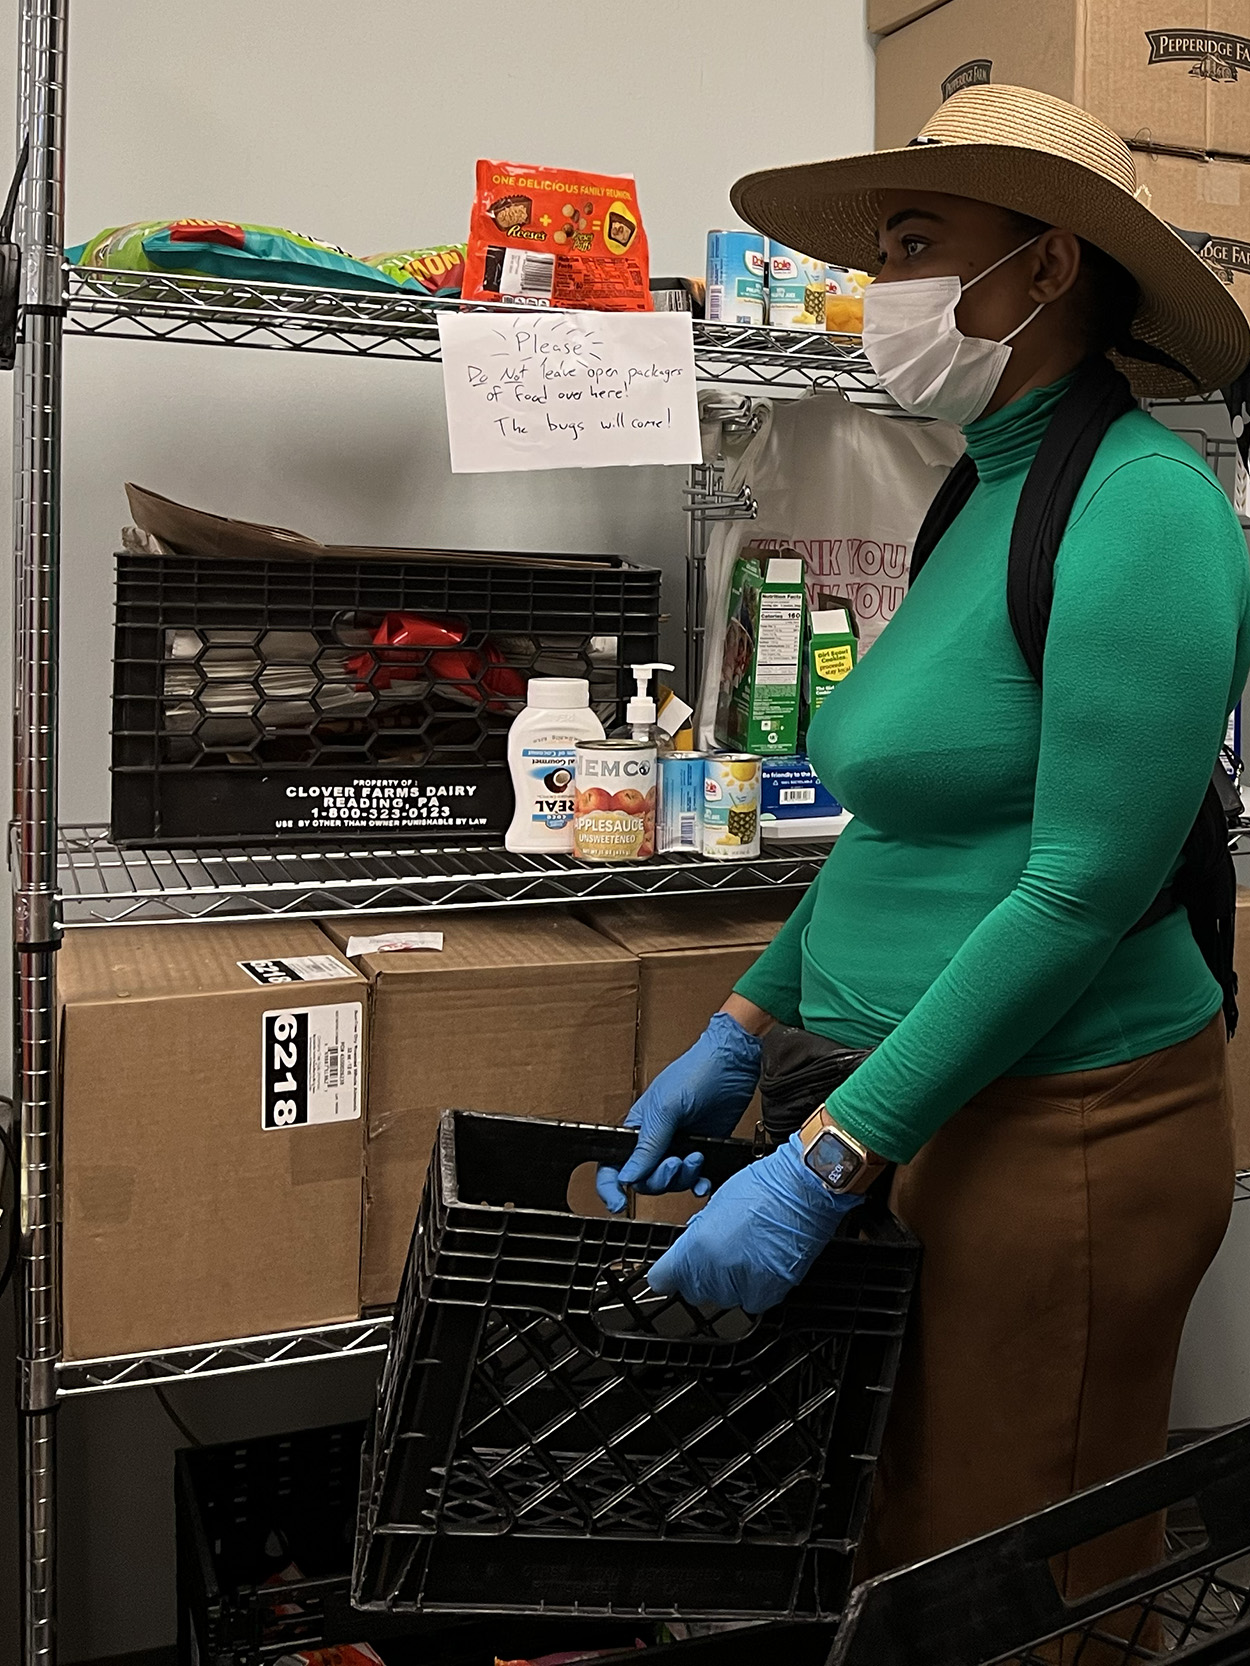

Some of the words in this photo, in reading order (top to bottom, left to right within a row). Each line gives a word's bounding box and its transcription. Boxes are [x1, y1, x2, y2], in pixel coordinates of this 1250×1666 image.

[1159, 35, 1233, 57] PEPPERIDGE
[492, 175, 516, 186] ONE
[518, 178, 579, 194] DELICIOUS
[580, 185, 605, 196] FAMILY
[507, 225, 547, 241] Reese's
[773, 259, 791, 269] Dole
[825, 282, 837, 293] ole
[515, 331, 583, 356] Please
[467, 364, 489, 384] Do
[500, 363, 529, 383] Not
[541, 364, 577, 380] leave
[586, 367, 619, 384] open
[627, 363, 685, 385] packages
[486, 385, 503, 403] of
[557, 390, 583, 401] over
[590, 382, 630, 400] here!
[494, 416, 529, 437] The
[546, 412, 585, 441] bugs
[600, 412, 625, 430] will
[631, 407, 672, 430] come!
[847, 538, 907, 579] YOU
[820, 661, 845, 671] proceeds
[532, 758, 566, 767] Gourmet
[353, 779, 399, 787] PROPERTY
[285, 786, 355, 798] CLOVER
[362, 786, 420, 798] FARMS
[426, 785, 477, 797] DAIRY
[323, 797, 410, 810] READING,
[417, 796, 440, 808] PA
[311, 806, 451, 819] 1-800-323-0123
[275, 820, 294, 828] USE
[298, 819, 311, 828] BY
[312, 819, 342, 828] OTHER
[344, 819, 367, 827] THAN
[368, 819, 400, 827] OWNER
[402, 818, 454, 827] PUNISHABLE
[455, 818, 468, 826] BY
[469, 817, 488, 826] LAW
[579, 833, 636, 844] UNSWEETENED
[273, 1012, 298, 1126] 6218
